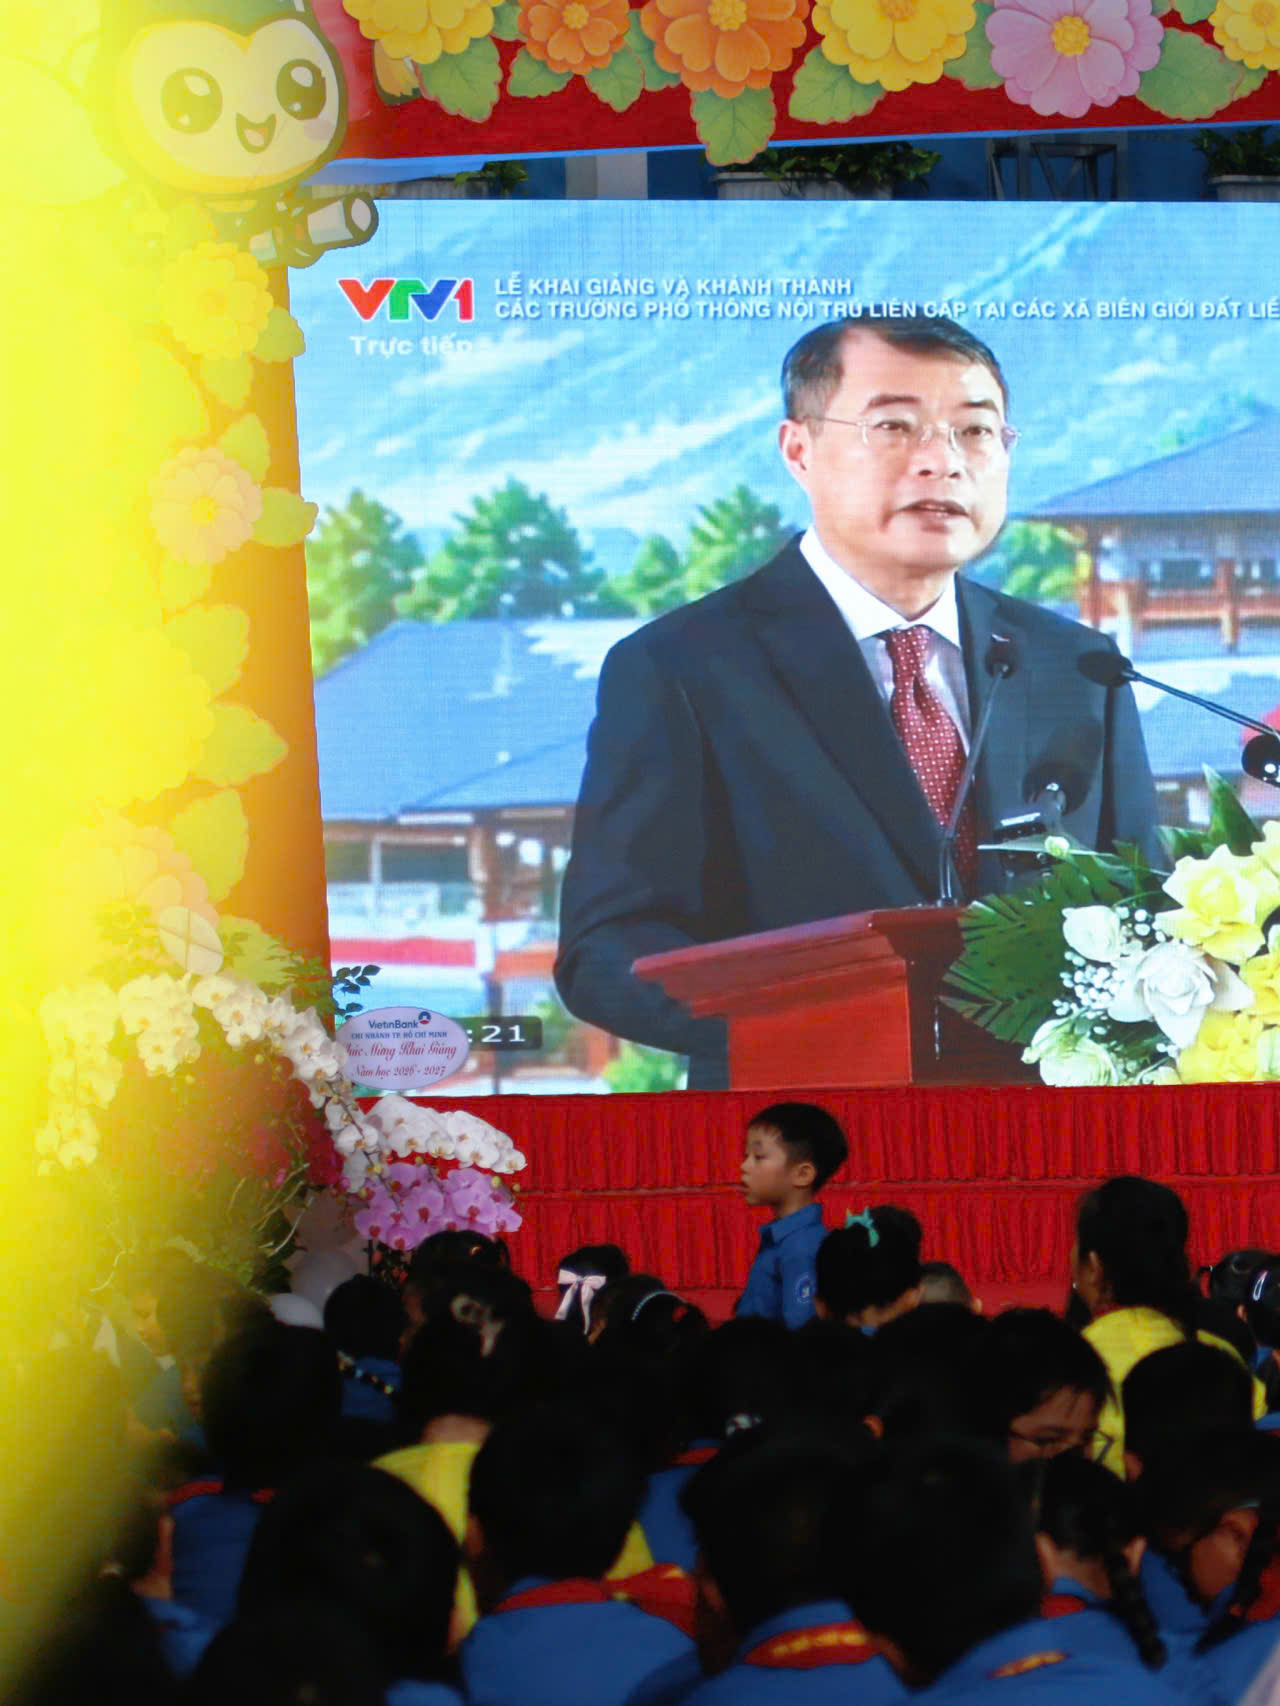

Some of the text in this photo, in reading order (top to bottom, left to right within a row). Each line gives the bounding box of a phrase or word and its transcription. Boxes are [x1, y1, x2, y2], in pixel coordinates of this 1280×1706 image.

[528, 279, 580, 294] KHAI
[587, 273, 655, 294] GIẢNG
[663, 273, 690, 294] VÀ
[697, 272, 771, 294] KHÁNH
[779, 272, 851, 294] THÀNH
[337, 278, 474, 321] VTV1
[496, 295, 541, 318] CÁC
[548, 295, 637, 318] TRƯỜNG
[696, 296, 770, 317] THÔNG
[778, 296, 813, 321] NỘI
[820, 296, 863, 318] TRÚ
[869, 296, 917, 318] LIÊN
[924, 296, 967, 318] CẤP
[973, 301, 1006, 321] TẠI
[1012, 297, 1056, 318] CÁC
[1062, 297, 1090, 317] XÃ
[1096, 297, 1145, 317] BIÊN
[1151, 295, 1194, 317] GIỚI
[1200, 296, 1242, 317] ĐẤT
[349, 332, 473, 359] Trực tiếp
[368, 1019, 418, 1029] VietinBank
